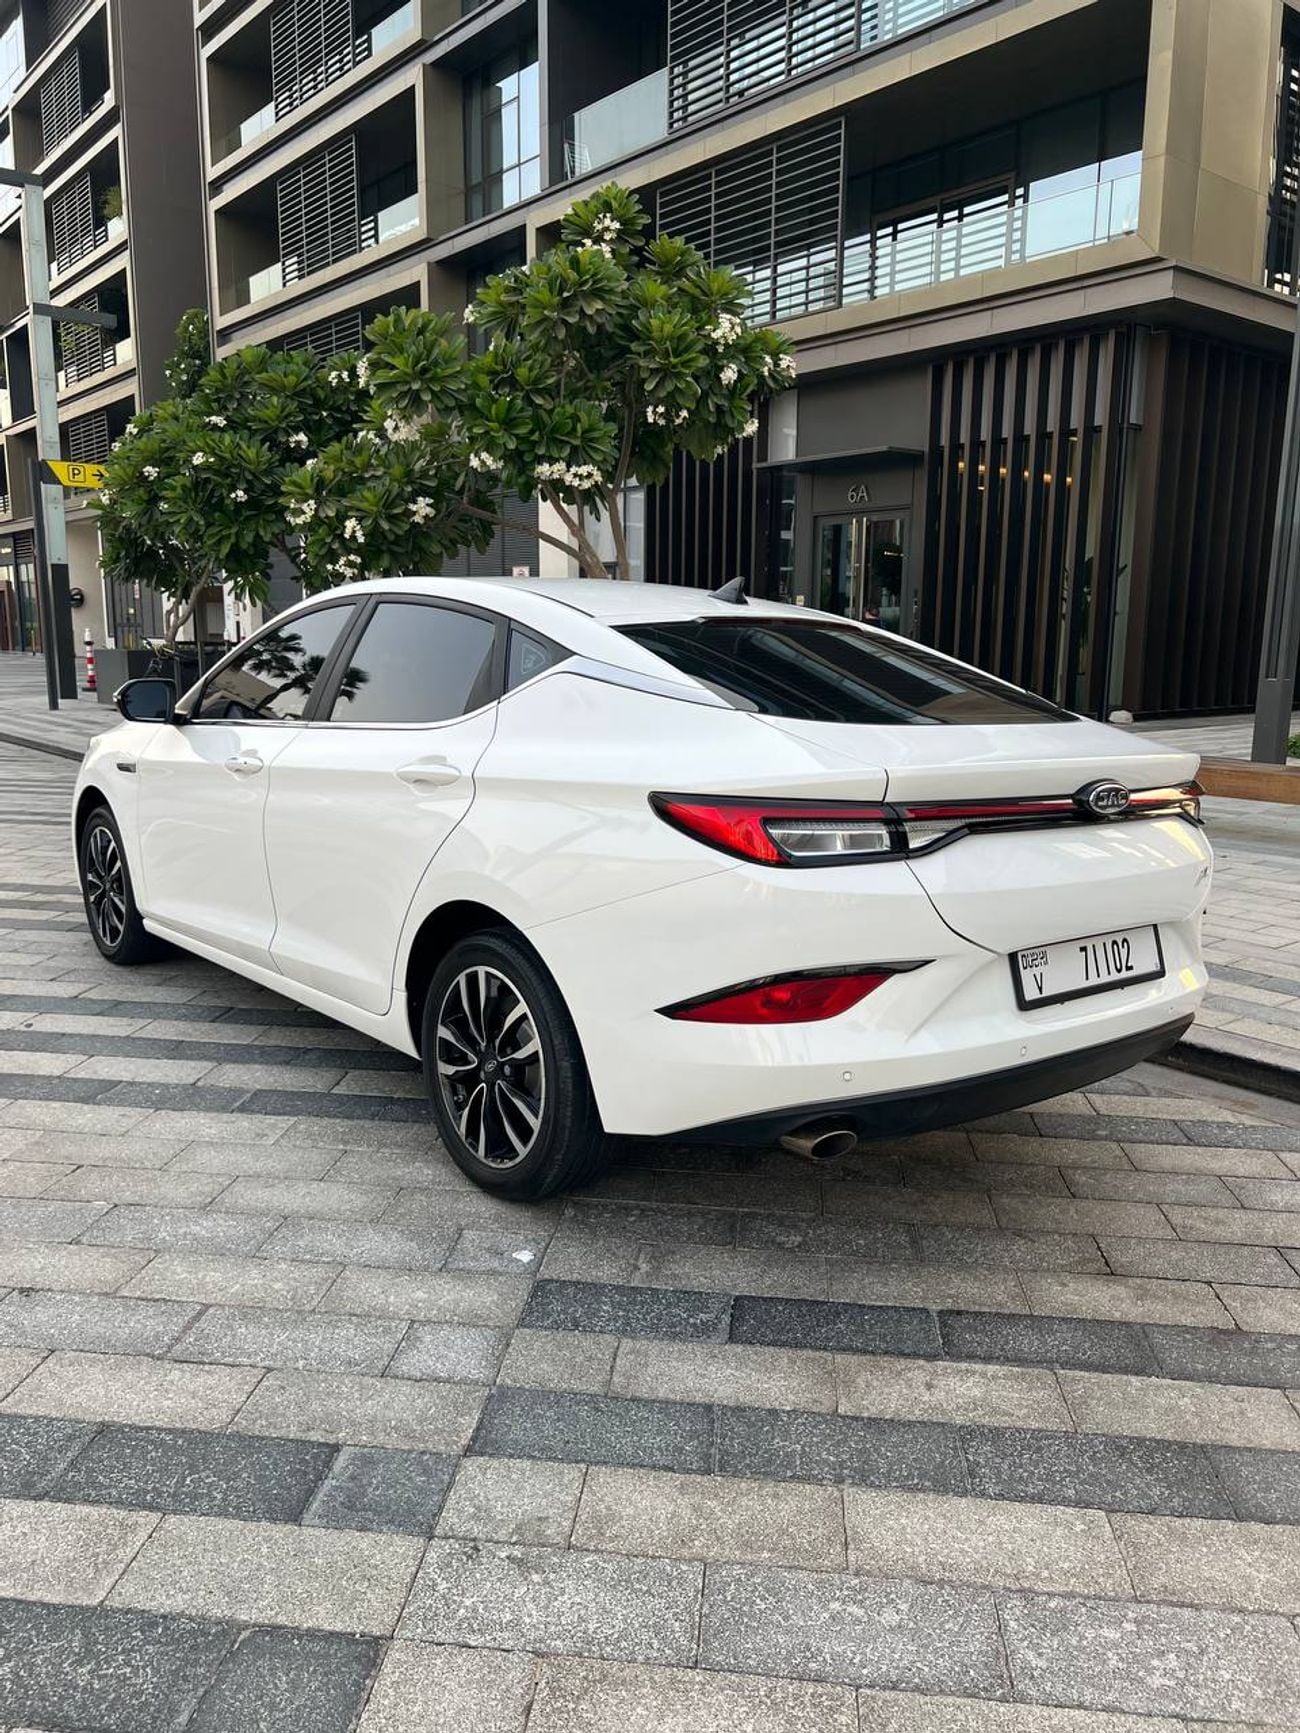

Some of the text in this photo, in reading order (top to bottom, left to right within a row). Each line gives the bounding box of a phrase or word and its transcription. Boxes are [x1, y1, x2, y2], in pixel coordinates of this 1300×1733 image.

[847, 485, 869, 503] 6A
[1097, 790, 1127, 806] JAC
[1079, 937, 1134, 981] 71102
[1033, 972, 1043, 995] V
